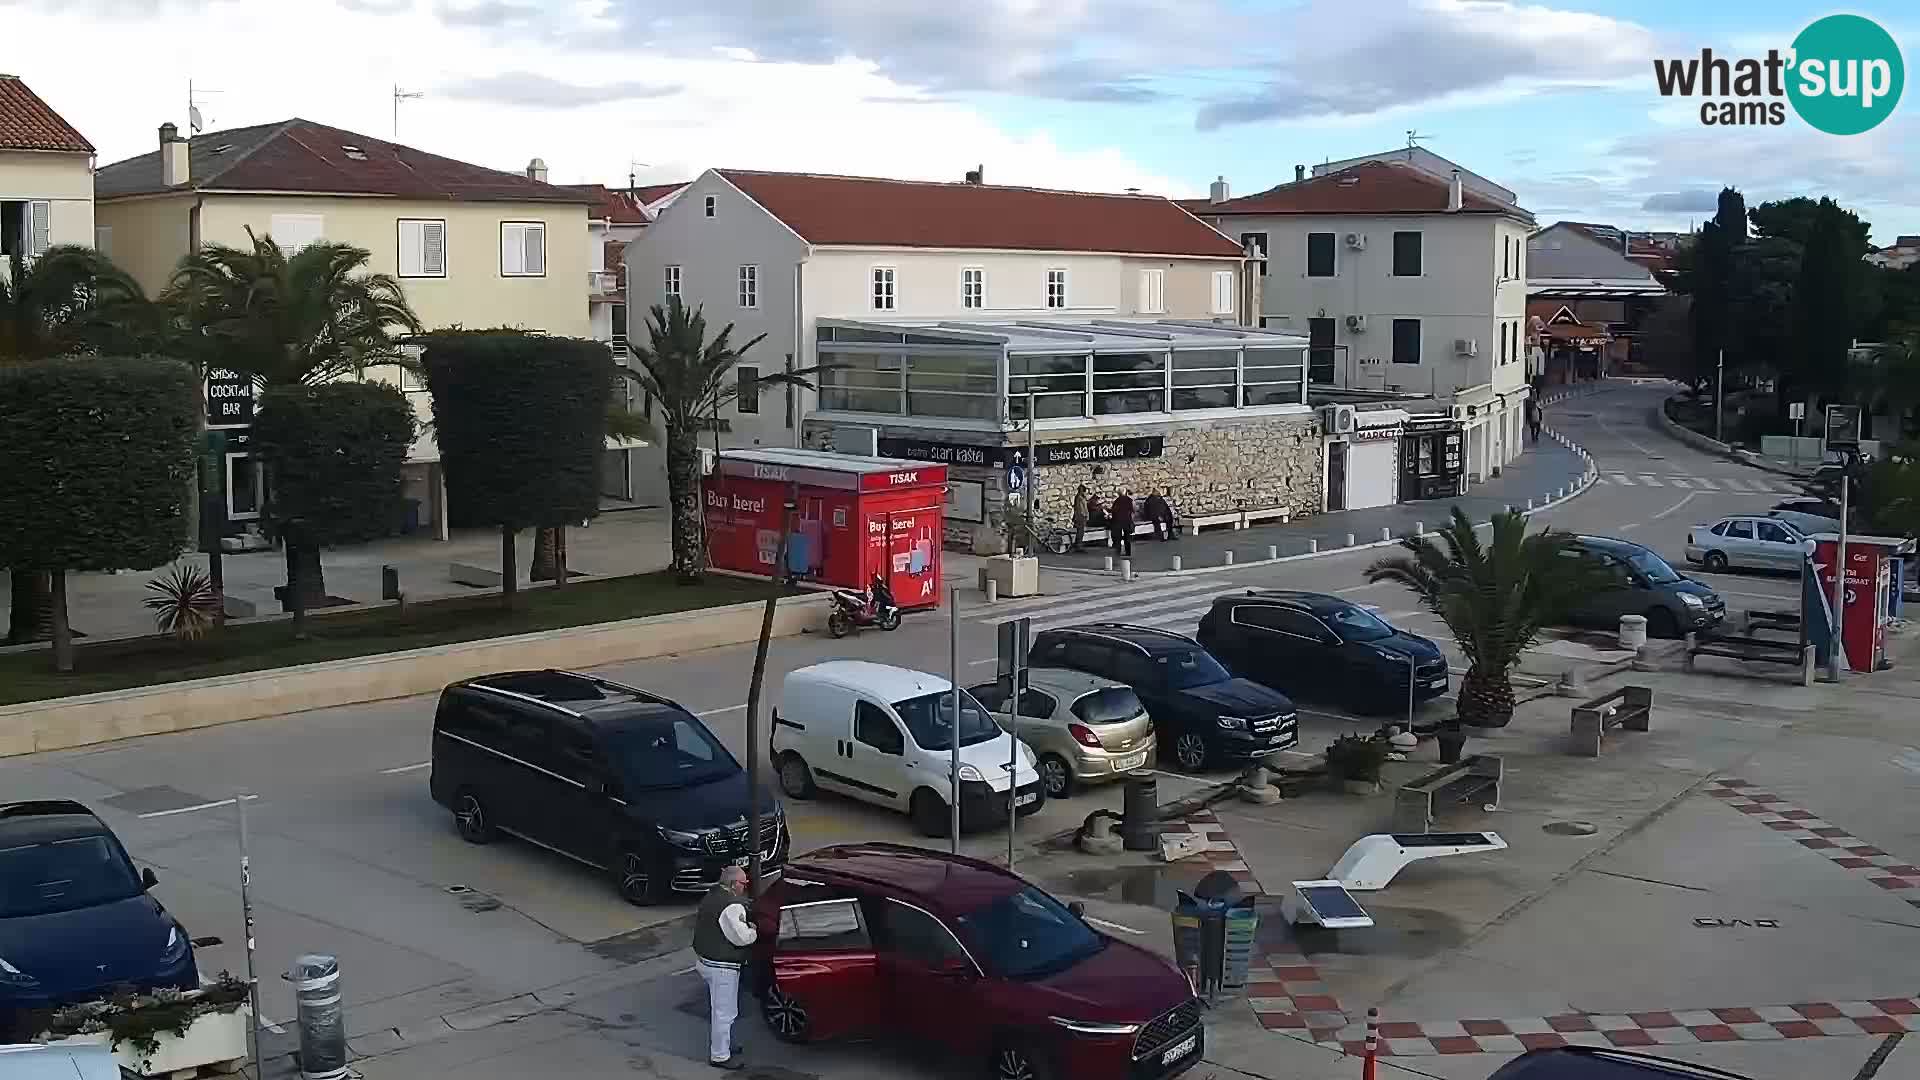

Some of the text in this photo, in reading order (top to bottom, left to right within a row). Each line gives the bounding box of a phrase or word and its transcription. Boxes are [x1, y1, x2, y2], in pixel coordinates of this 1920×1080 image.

[210, 385, 250, 398] COCKTAIL
[222, 403, 241, 416] BAR
[753, 463, 789, 481] TISAK
[889, 471, 918, 485] TISAK
[733, 493, 765, 513] here!
[869, 521, 887, 534] Buy
